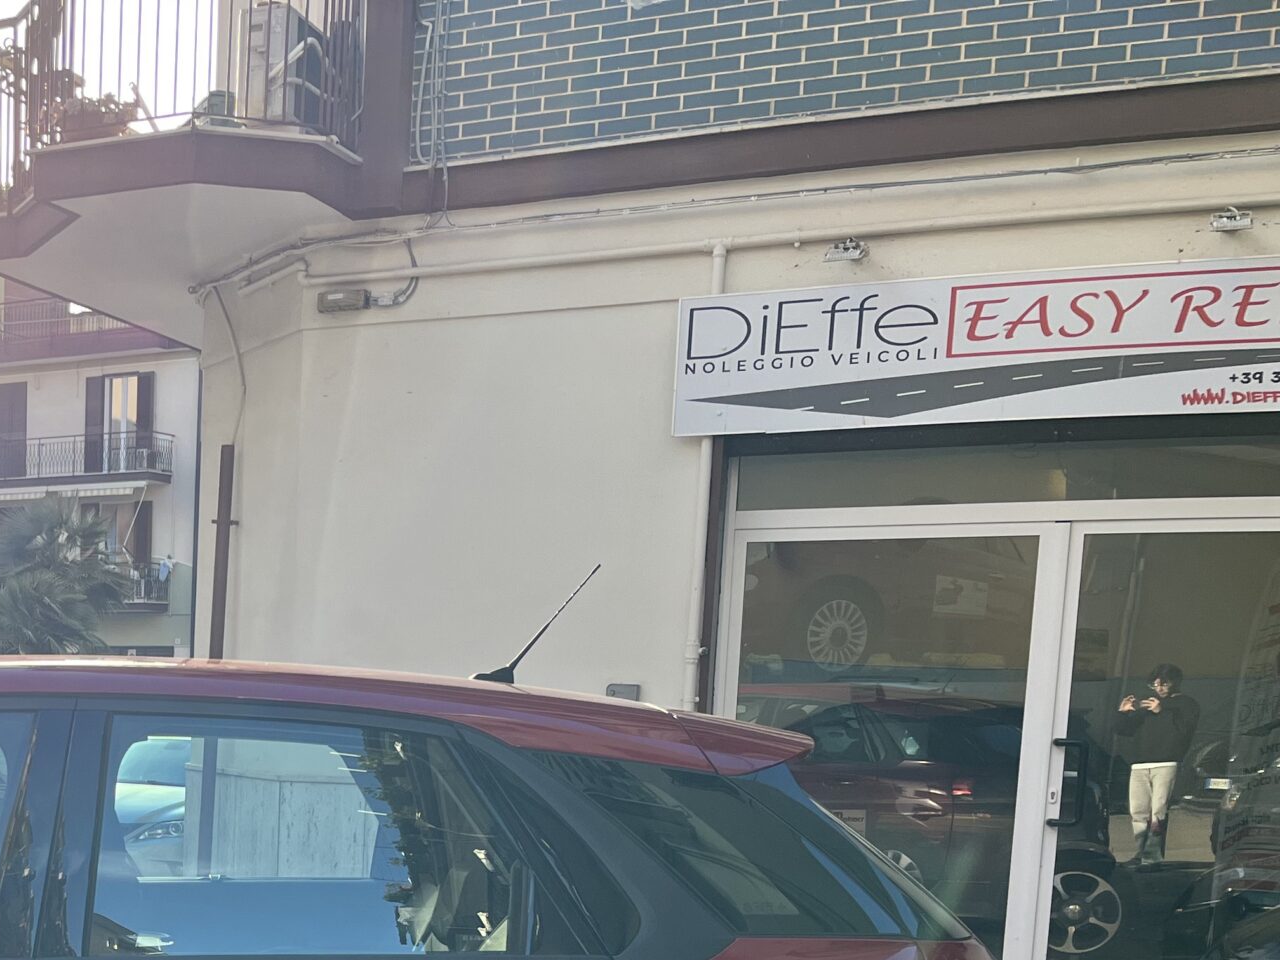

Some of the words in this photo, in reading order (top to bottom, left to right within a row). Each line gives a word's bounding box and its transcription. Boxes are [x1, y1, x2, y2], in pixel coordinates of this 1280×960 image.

[687, 294, 939, 360] DiEffe
[964, 289, 1150, 342] EASY
[1170, 282, 1280, 334] RE
[685, 355, 814, 375] NOLEGGIO
[831, 347, 938, 366] VEICOLI
[1229, 371, 1264, 384] +39
